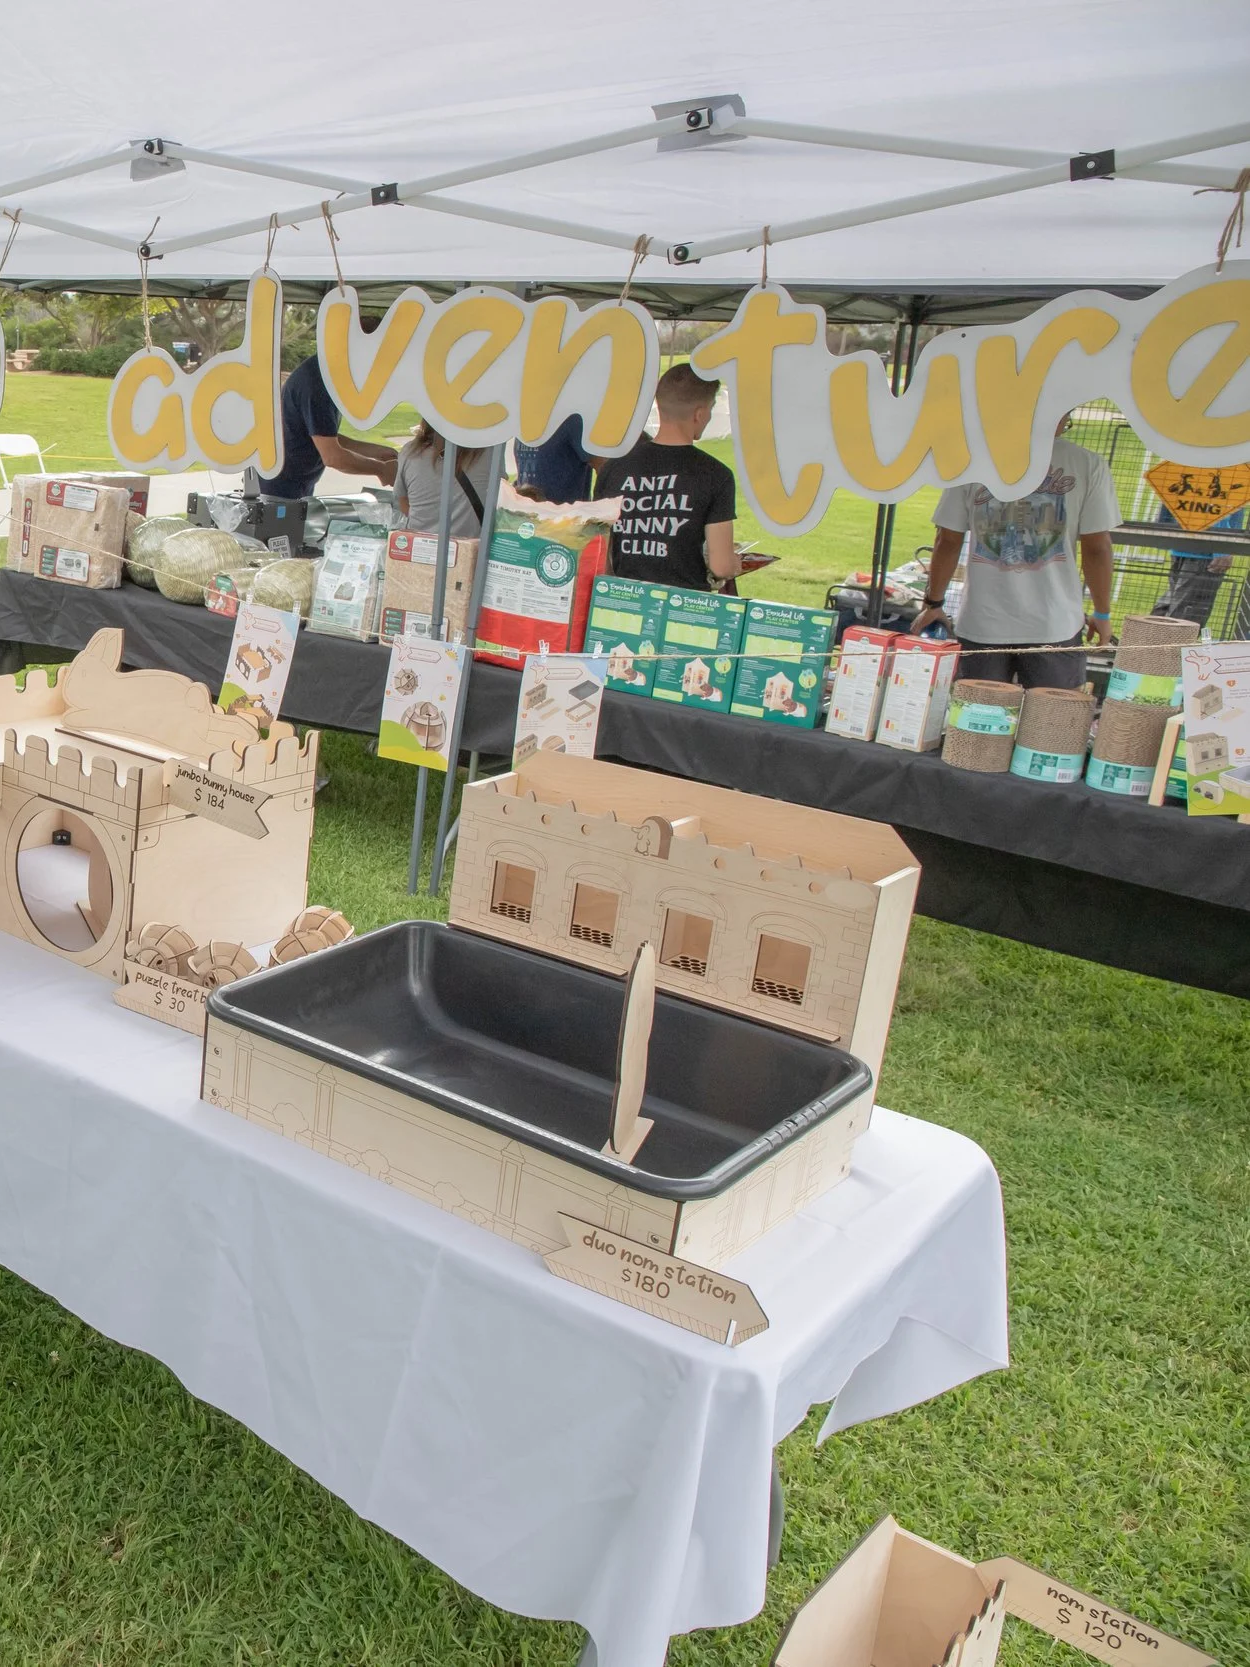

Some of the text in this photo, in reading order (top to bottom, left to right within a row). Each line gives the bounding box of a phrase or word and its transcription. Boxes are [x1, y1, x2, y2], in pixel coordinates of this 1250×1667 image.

[620, 474, 678, 492] ANTI
[620, 494, 694, 512] OCIAL
[1176, 500, 1223, 516] XING
[620, 539, 668, 558] CLUB
[175, 764, 255, 804] jumbo bunny house
[194, 787, 225, 810] $ 184
[135, 972, 169, 991] puzzle
[171, 981, 199, 1002] treat
[153, 991, 164, 1006] $
[169, 997, 186, 1013] 30
[582, 1230, 737, 1305] duo nom station
[621, 1268, 671, 1299] $180
[1047, 1586, 1160, 1650] nom station
[1056, 1608, 1122, 1650] $ 120
